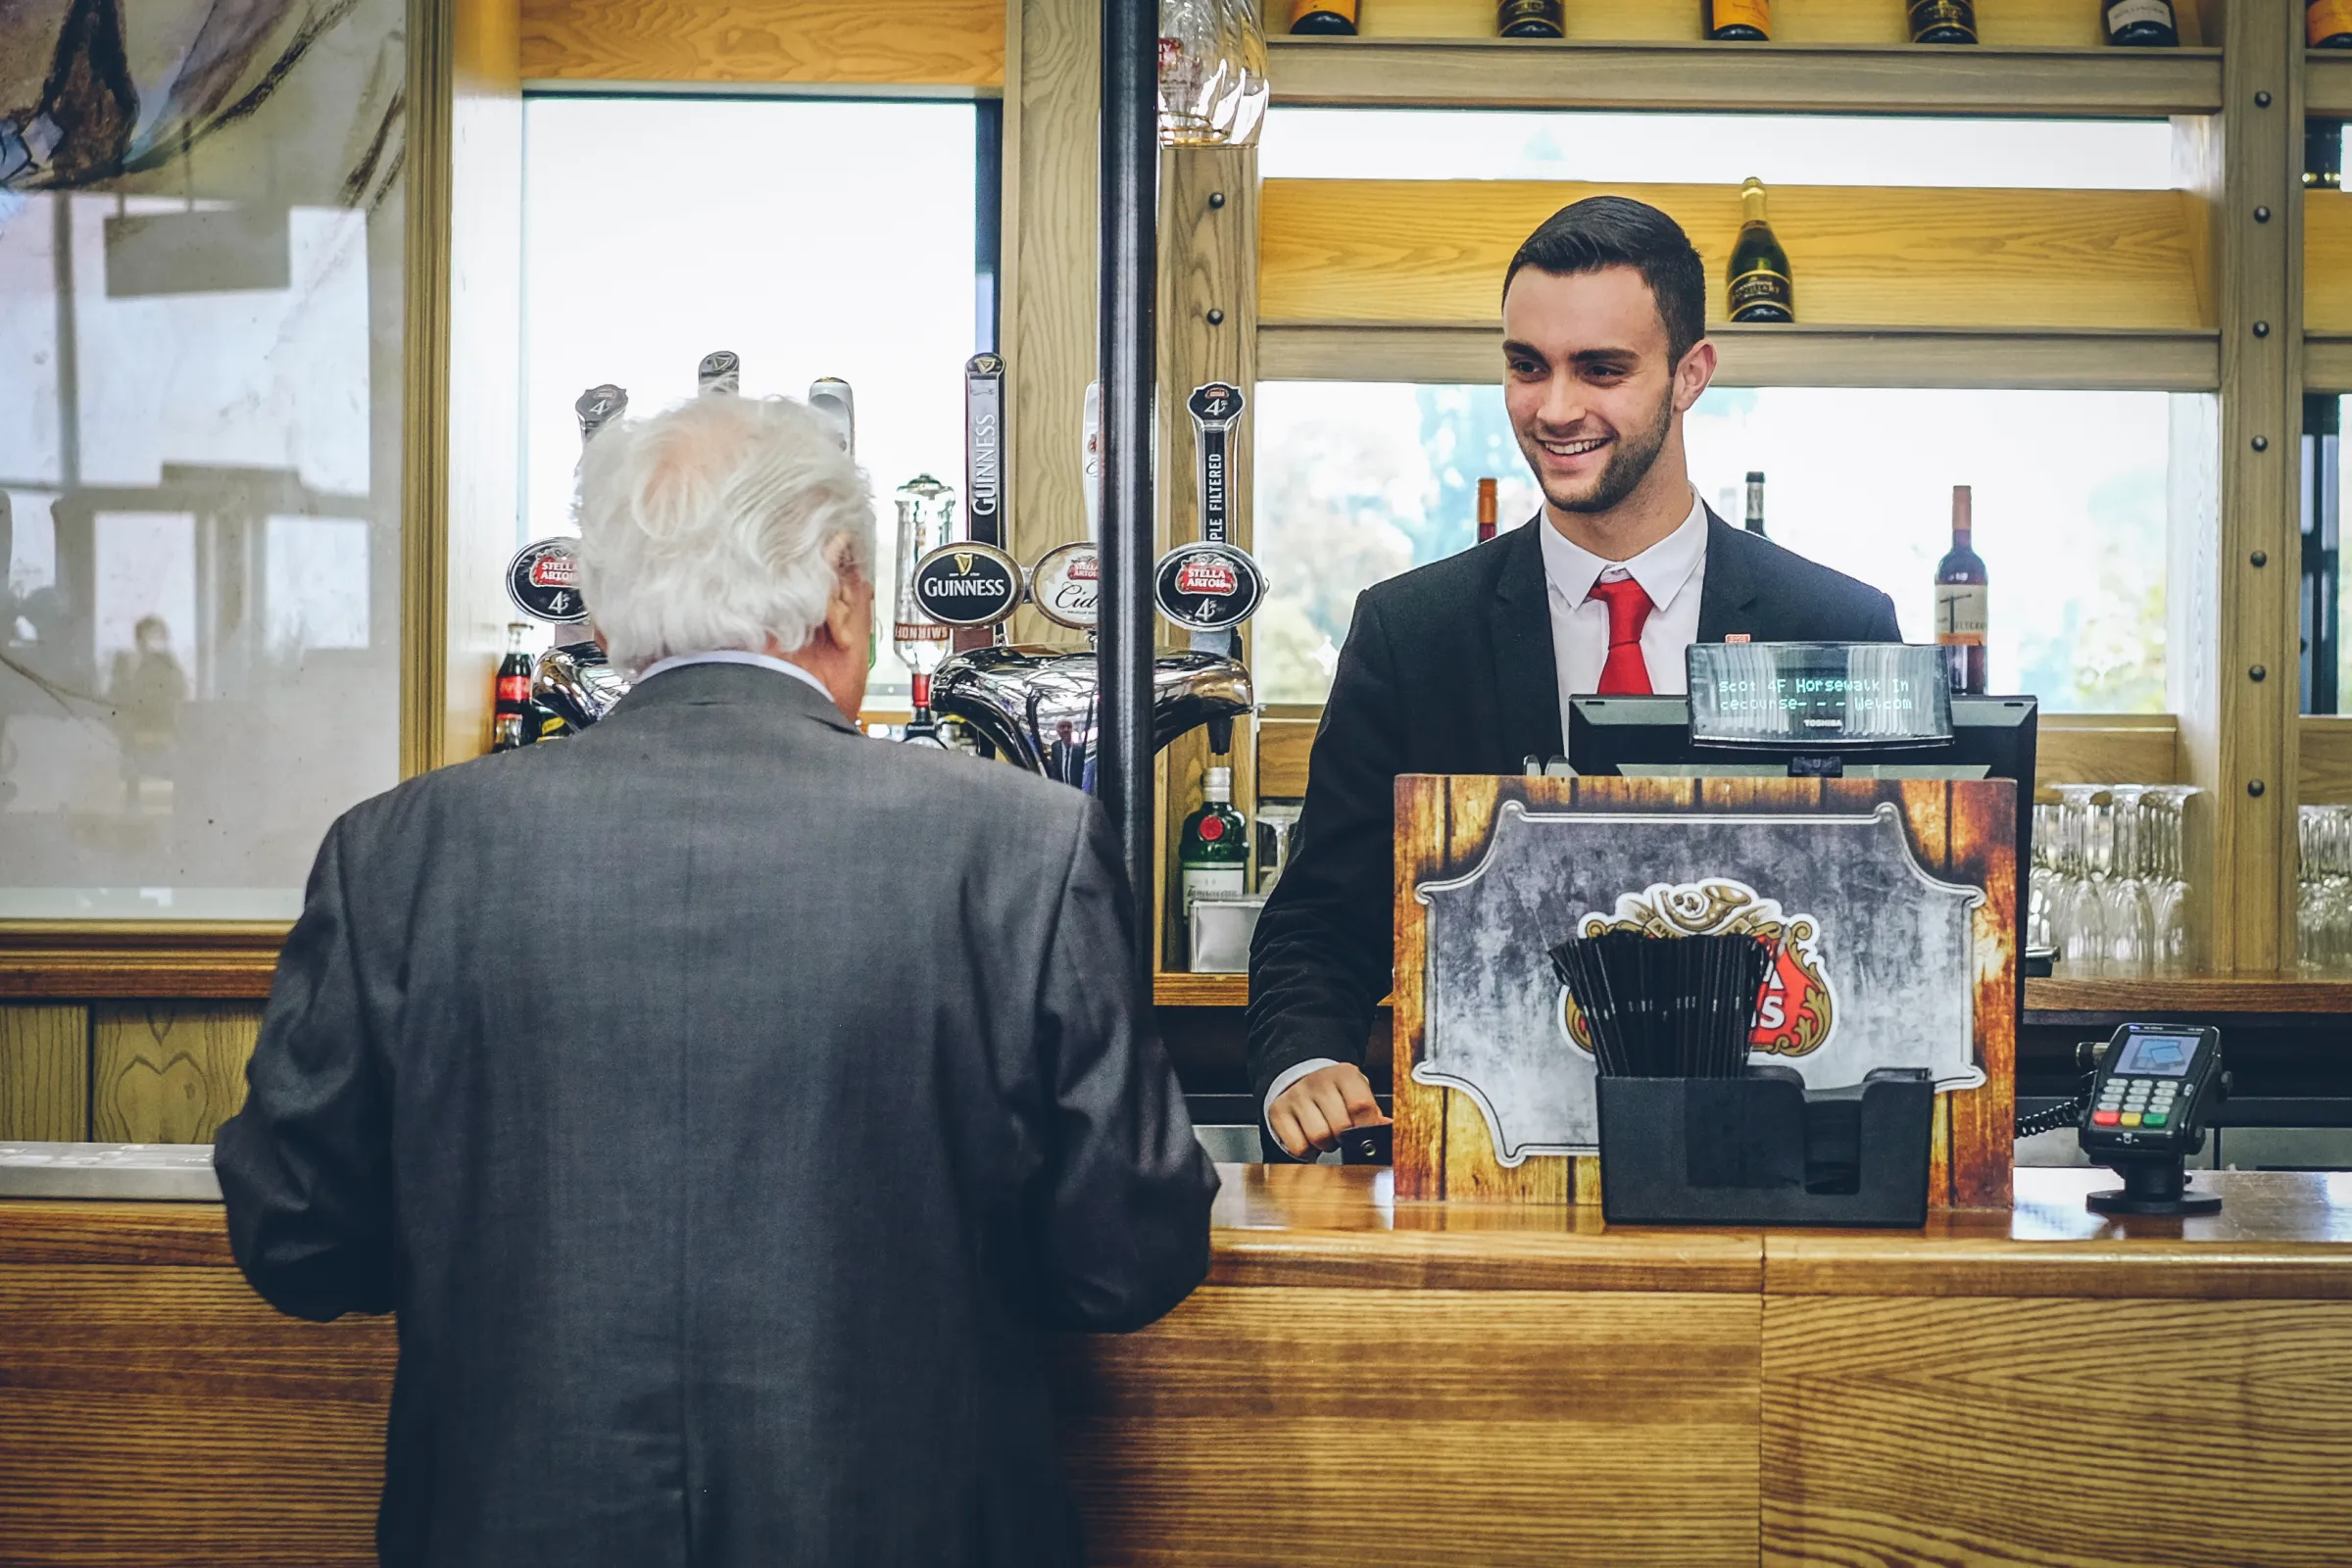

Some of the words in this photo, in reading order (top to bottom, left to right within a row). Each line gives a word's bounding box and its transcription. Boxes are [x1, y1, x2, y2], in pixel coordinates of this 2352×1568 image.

[972, 414, 997, 515] GUINNESS
[1208, 453, 1223, 511] FILTERED
[540, 570, 578, 580] ARTOI
[1188, 569, 1225, 578] STELLA
[924, 577, 1004, 597] GUINNESS
[1187, 578, 1226, 588] ARTOIS
[1055, 581, 1099, 609] Cid
[1767, 678, 1787, 693] 4F
[1795, 678, 1881, 693] Horsewalk
[1854, 697, 1913, 711] Welcom
[1803, 718, 1842, 727] TOSHIBA
